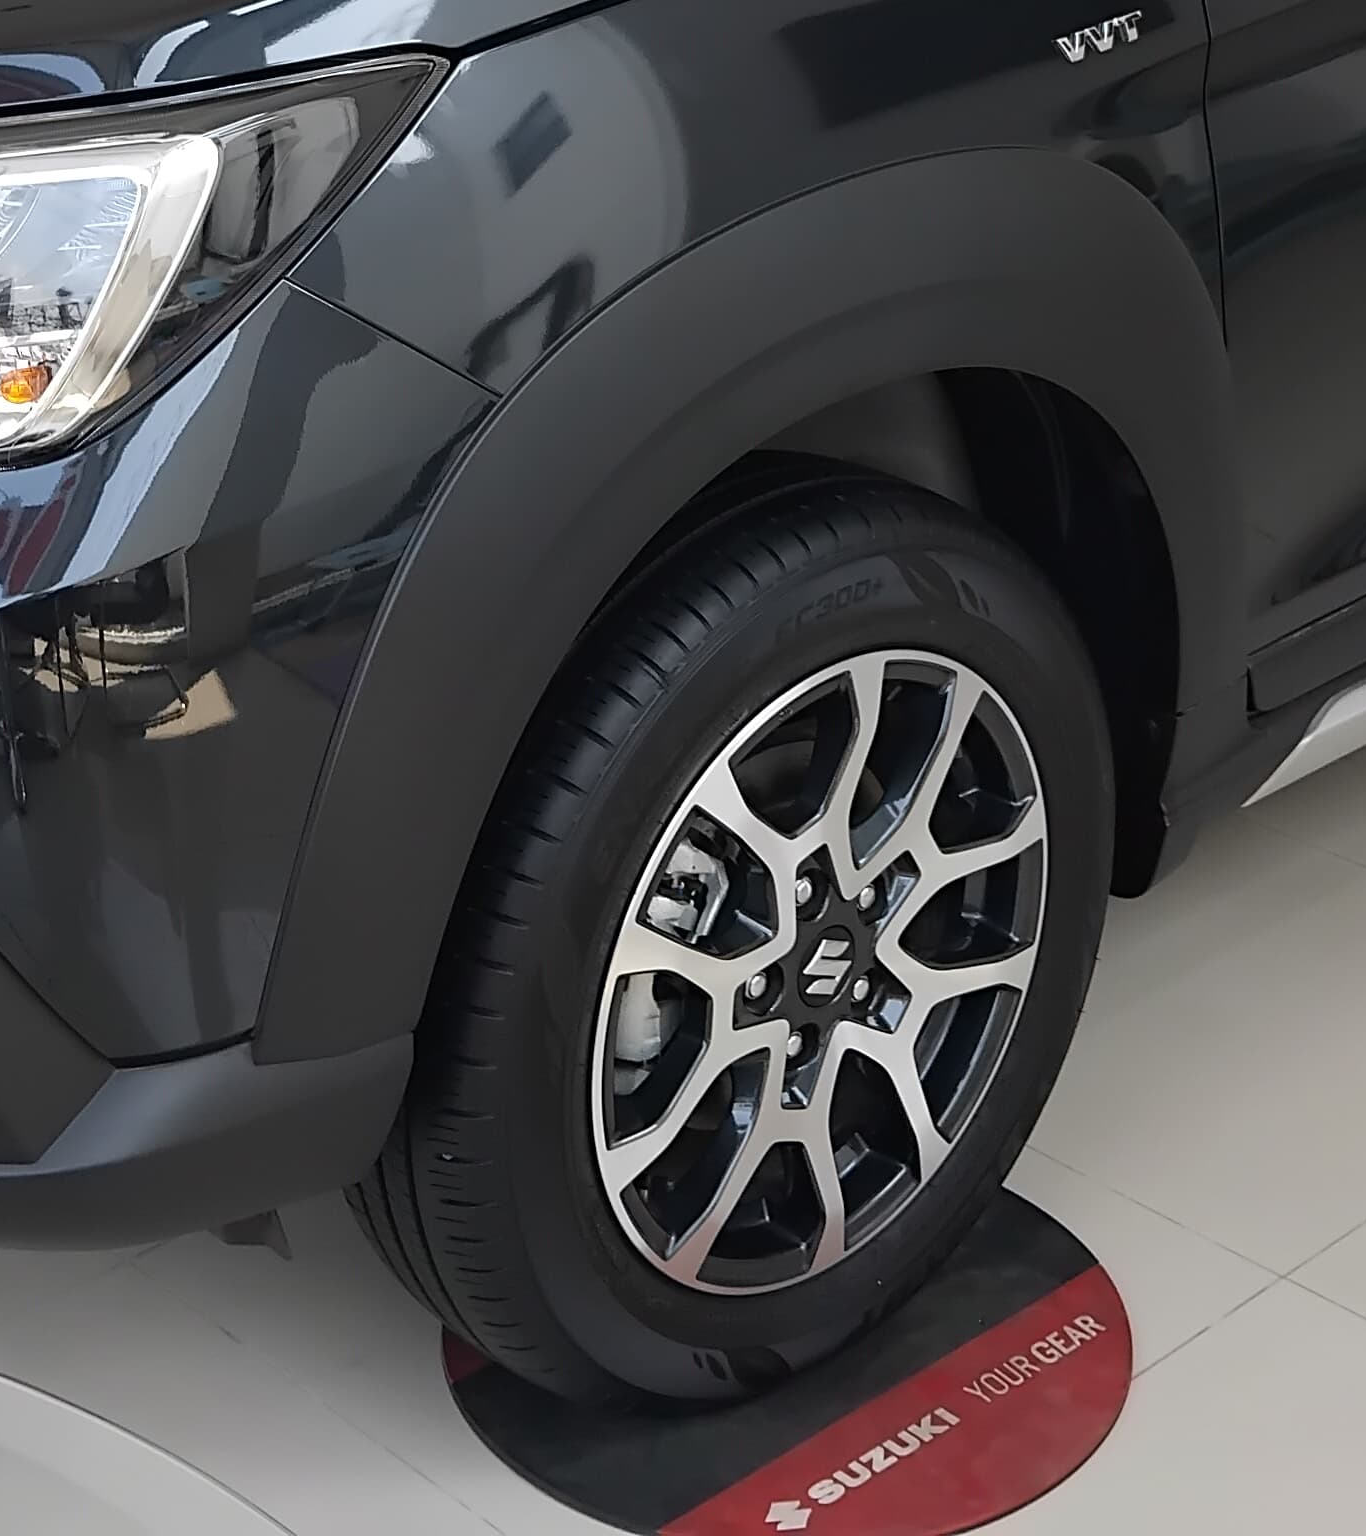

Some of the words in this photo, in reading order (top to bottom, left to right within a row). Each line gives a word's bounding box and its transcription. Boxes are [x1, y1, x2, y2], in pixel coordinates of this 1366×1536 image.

[1054, 9, 1143, 64] VVT
[806, 1406, 962, 1505] SUZUKI
[962, 1354, 1041, 1404] YOUR
[1029, 1312, 1108, 1365] GEAR
